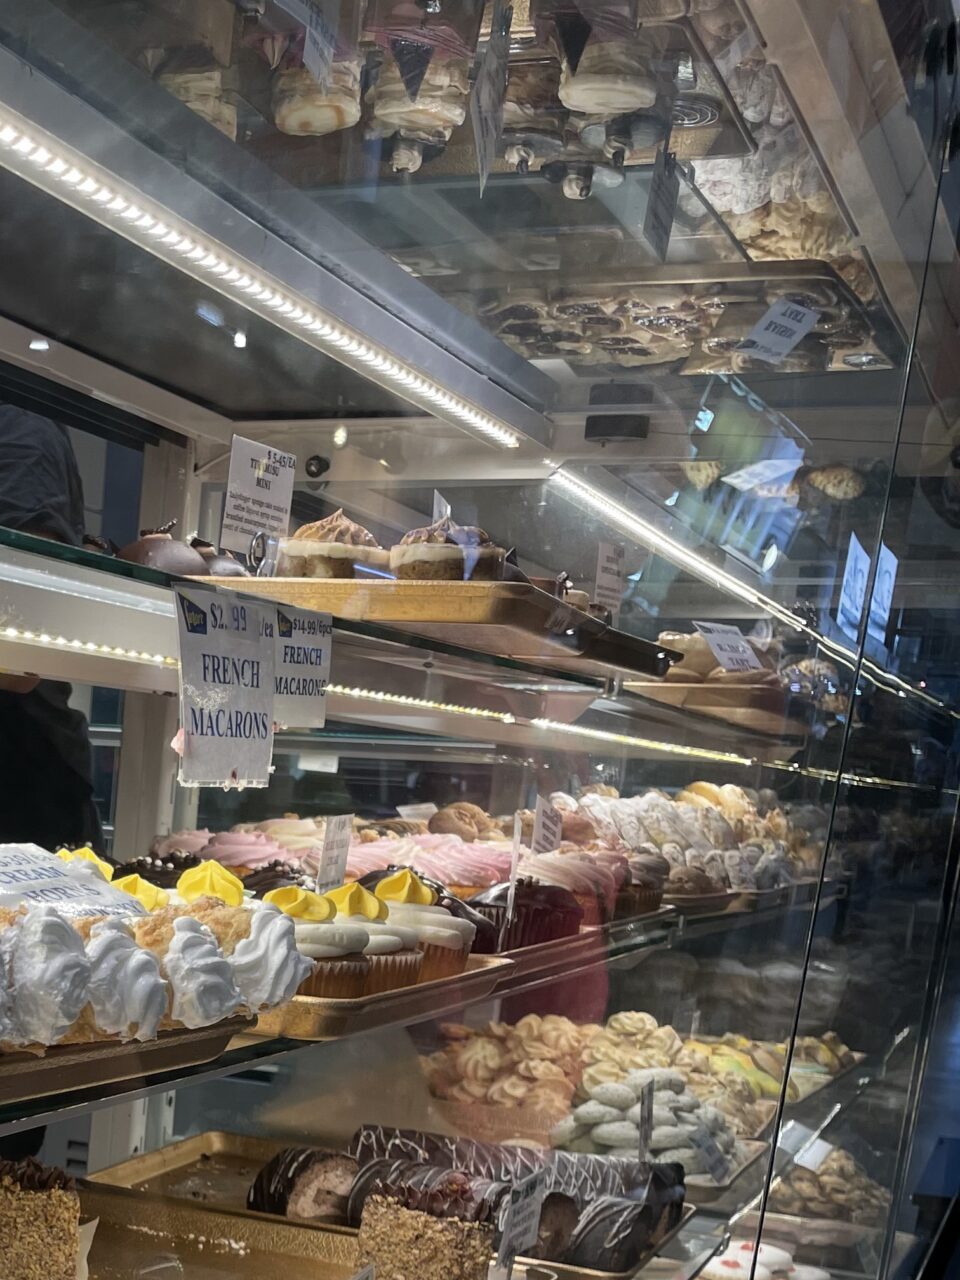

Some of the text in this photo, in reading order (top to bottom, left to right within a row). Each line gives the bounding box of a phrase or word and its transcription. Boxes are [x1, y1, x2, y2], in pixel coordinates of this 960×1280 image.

[250, 458, 280, 477] TIMISU
[255, 477, 272, 491] MINI
[283, 645, 323, 666] FRENCH
[202, 653, 260, 689] FRENCH
[274, 676, 326, 697] MACARONS
[190, 707, 268, 740] MACARONS
